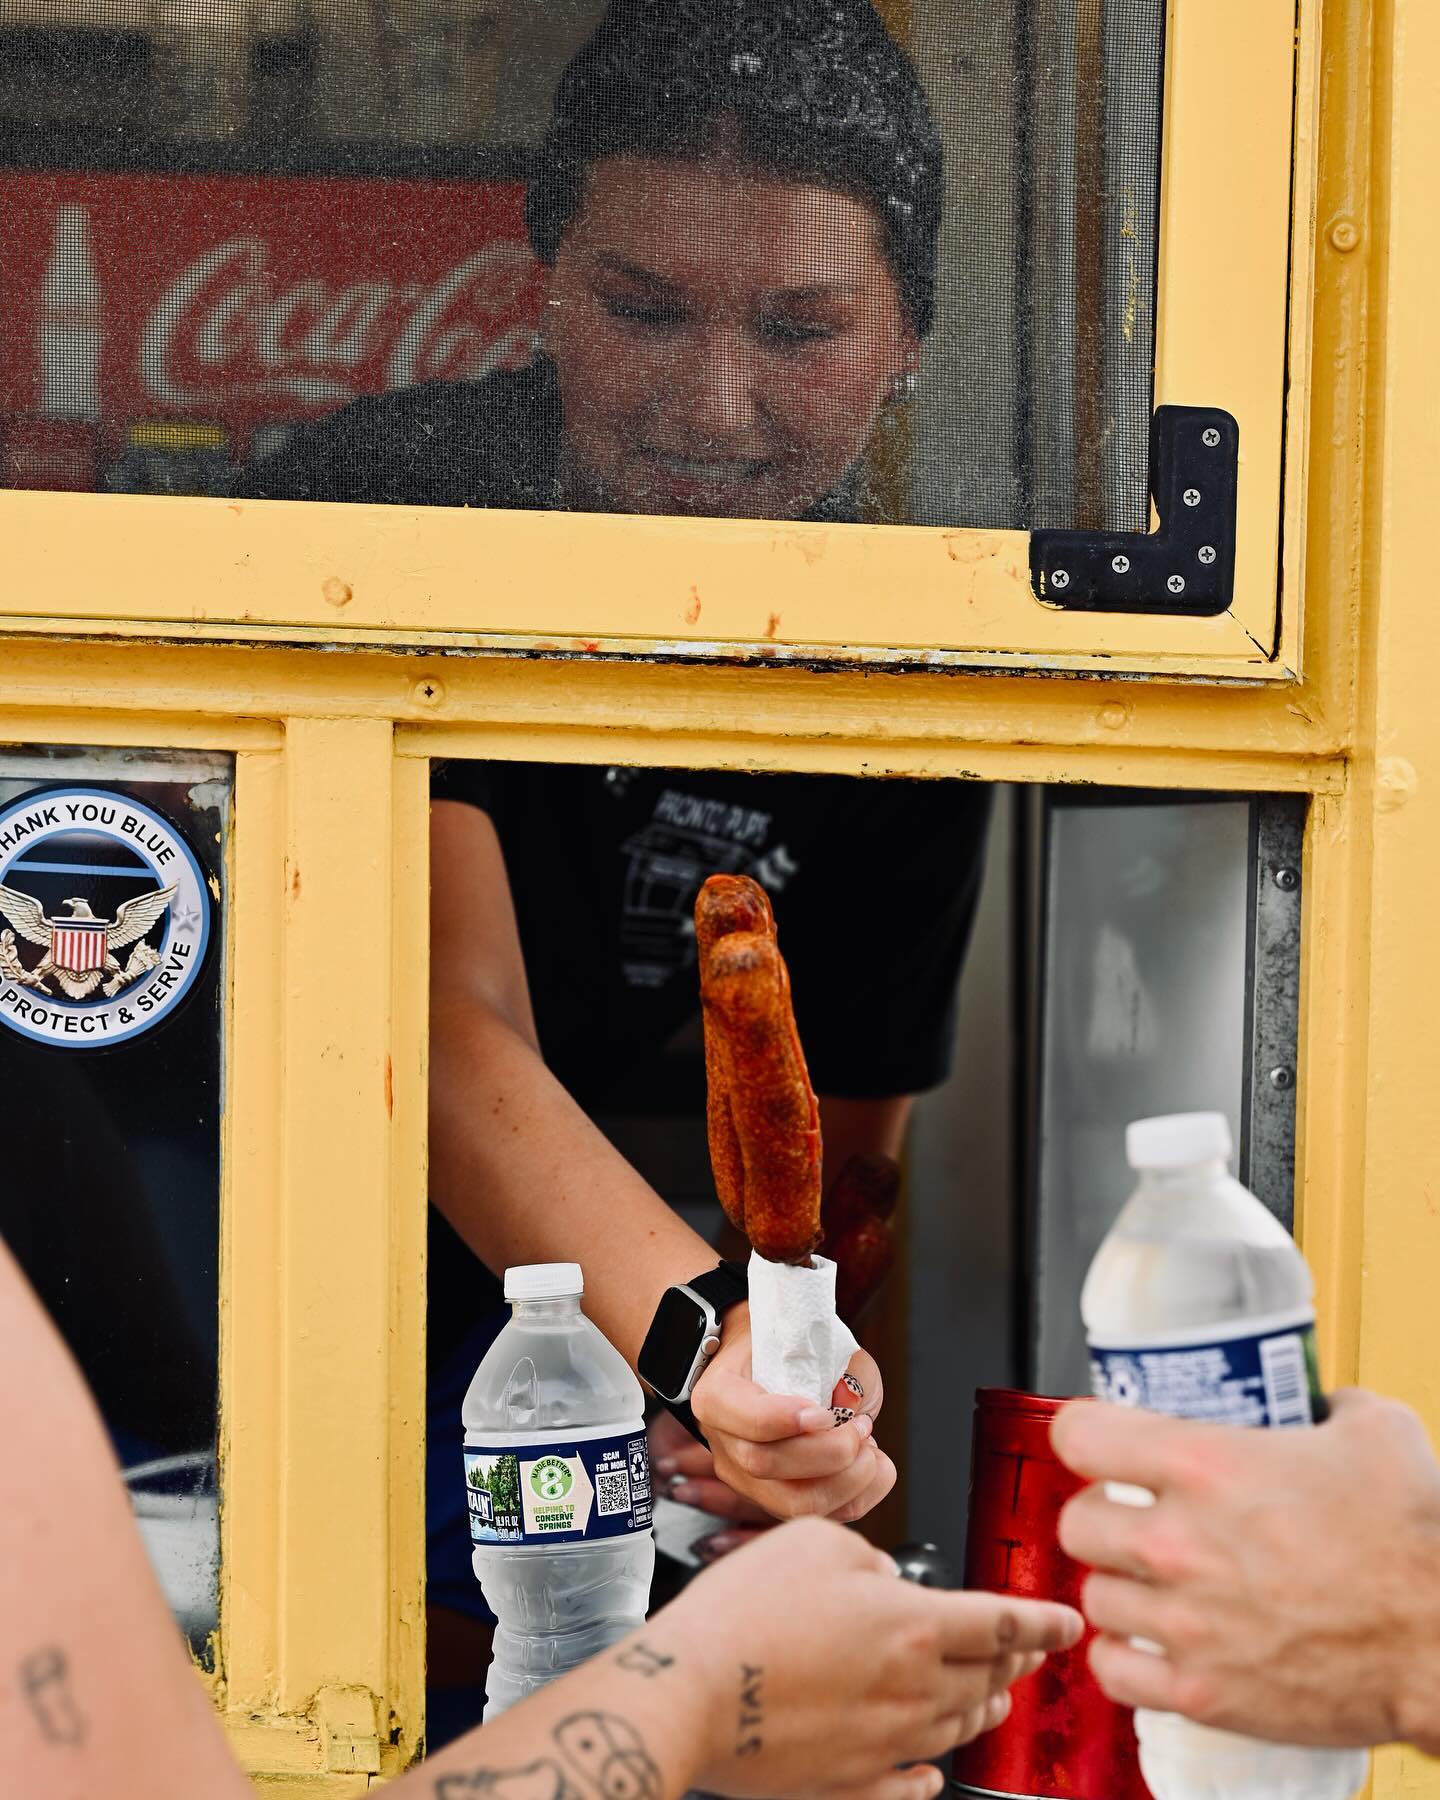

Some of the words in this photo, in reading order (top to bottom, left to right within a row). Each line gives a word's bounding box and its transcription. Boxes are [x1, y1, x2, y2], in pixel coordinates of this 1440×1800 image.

[0, 807, 60, 858] HANK
[66, 804, 116, 825] YOU
[120, 816, 176, 866] BLUE
[0, 988, 109, 1033] PROTECT
[119, 1007, 136, 1025] &
[136, 941, 192, 1012] SERVE
[602, 1451, 620, 1461] SCAN
[595, 1463, 609, 1472] FOR
[610, 1460, 627, 1470] MORE
[532, 1505, 564, 1514] HELPING
[566, 1504, 575, 1513] TO
[535, 1513, 574, 1522] CONSERVE
[538, 1521, 572, 1531] SPRINGS
[735, 1663, 763, 1758] STAY
